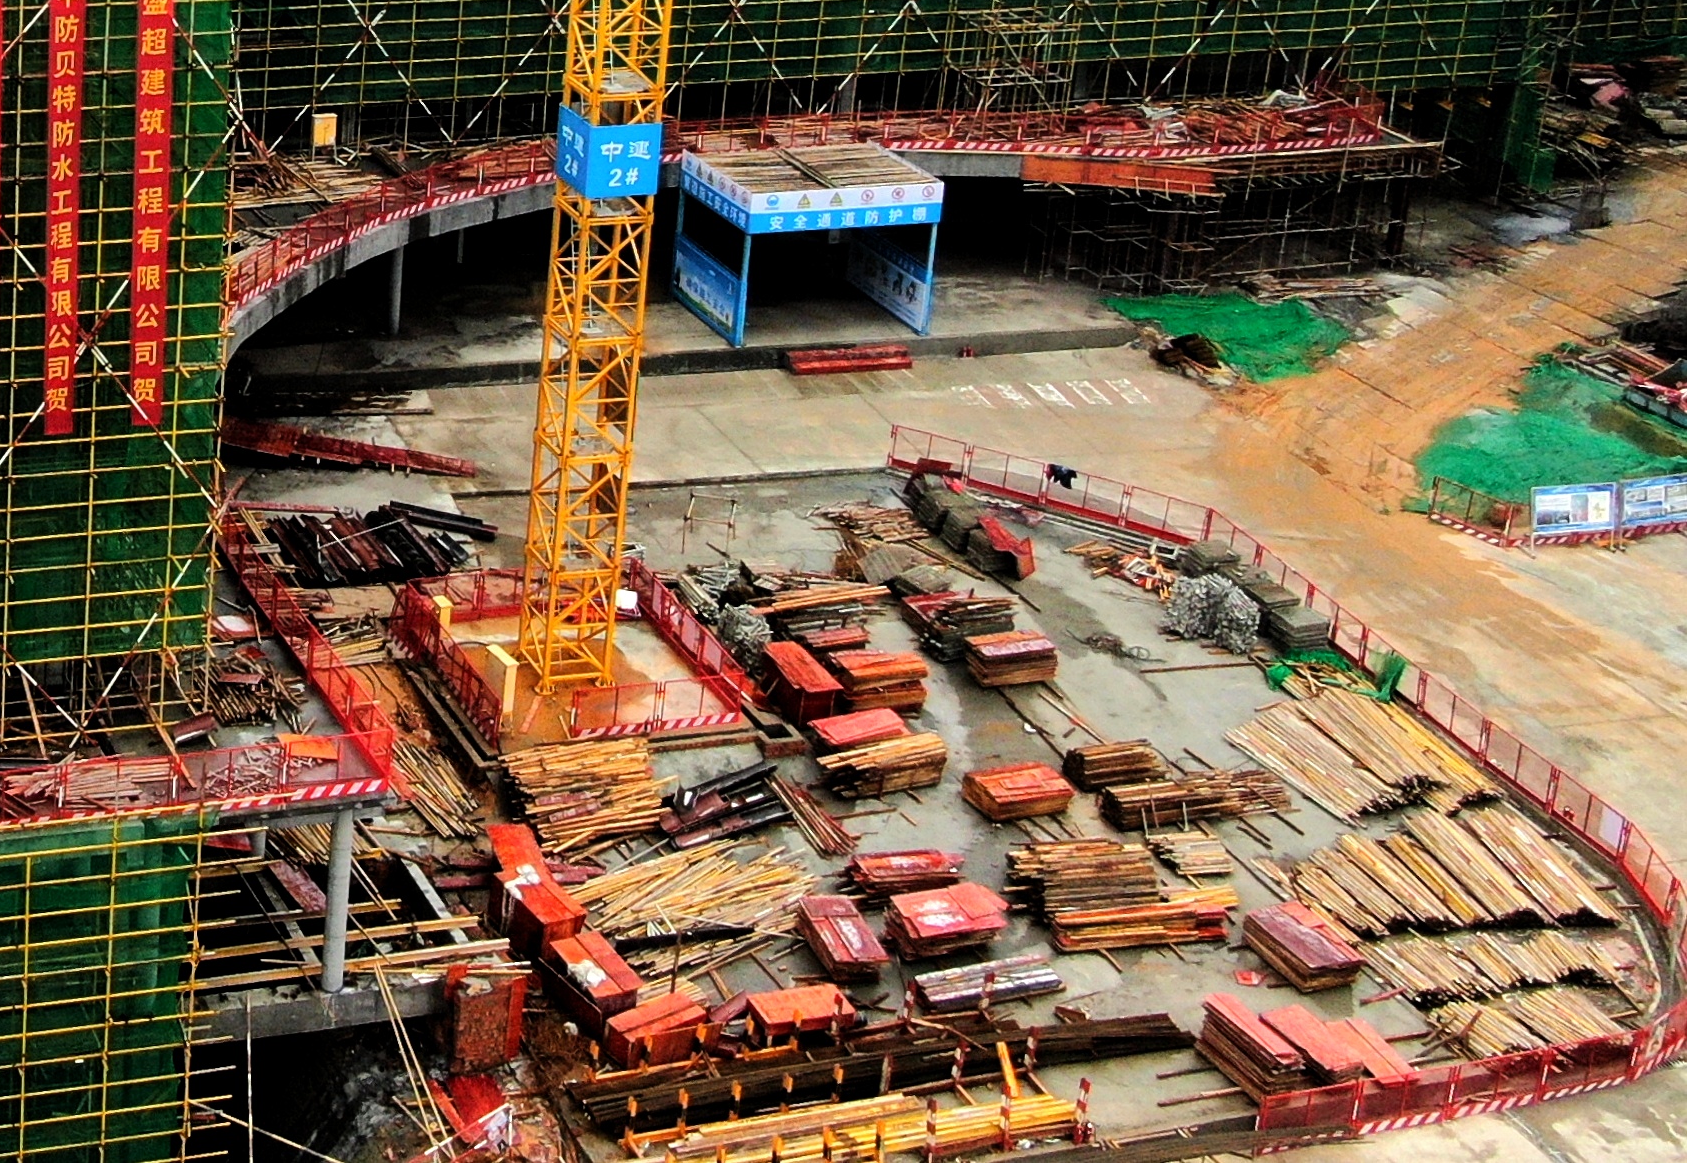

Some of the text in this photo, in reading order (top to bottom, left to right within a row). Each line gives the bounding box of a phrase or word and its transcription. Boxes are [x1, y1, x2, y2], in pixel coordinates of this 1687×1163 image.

[564, 154, 579, 178] 2#
[608, 167, 639, 187] 2#
[769, 206, 927, 231] 安全通道防护棚
